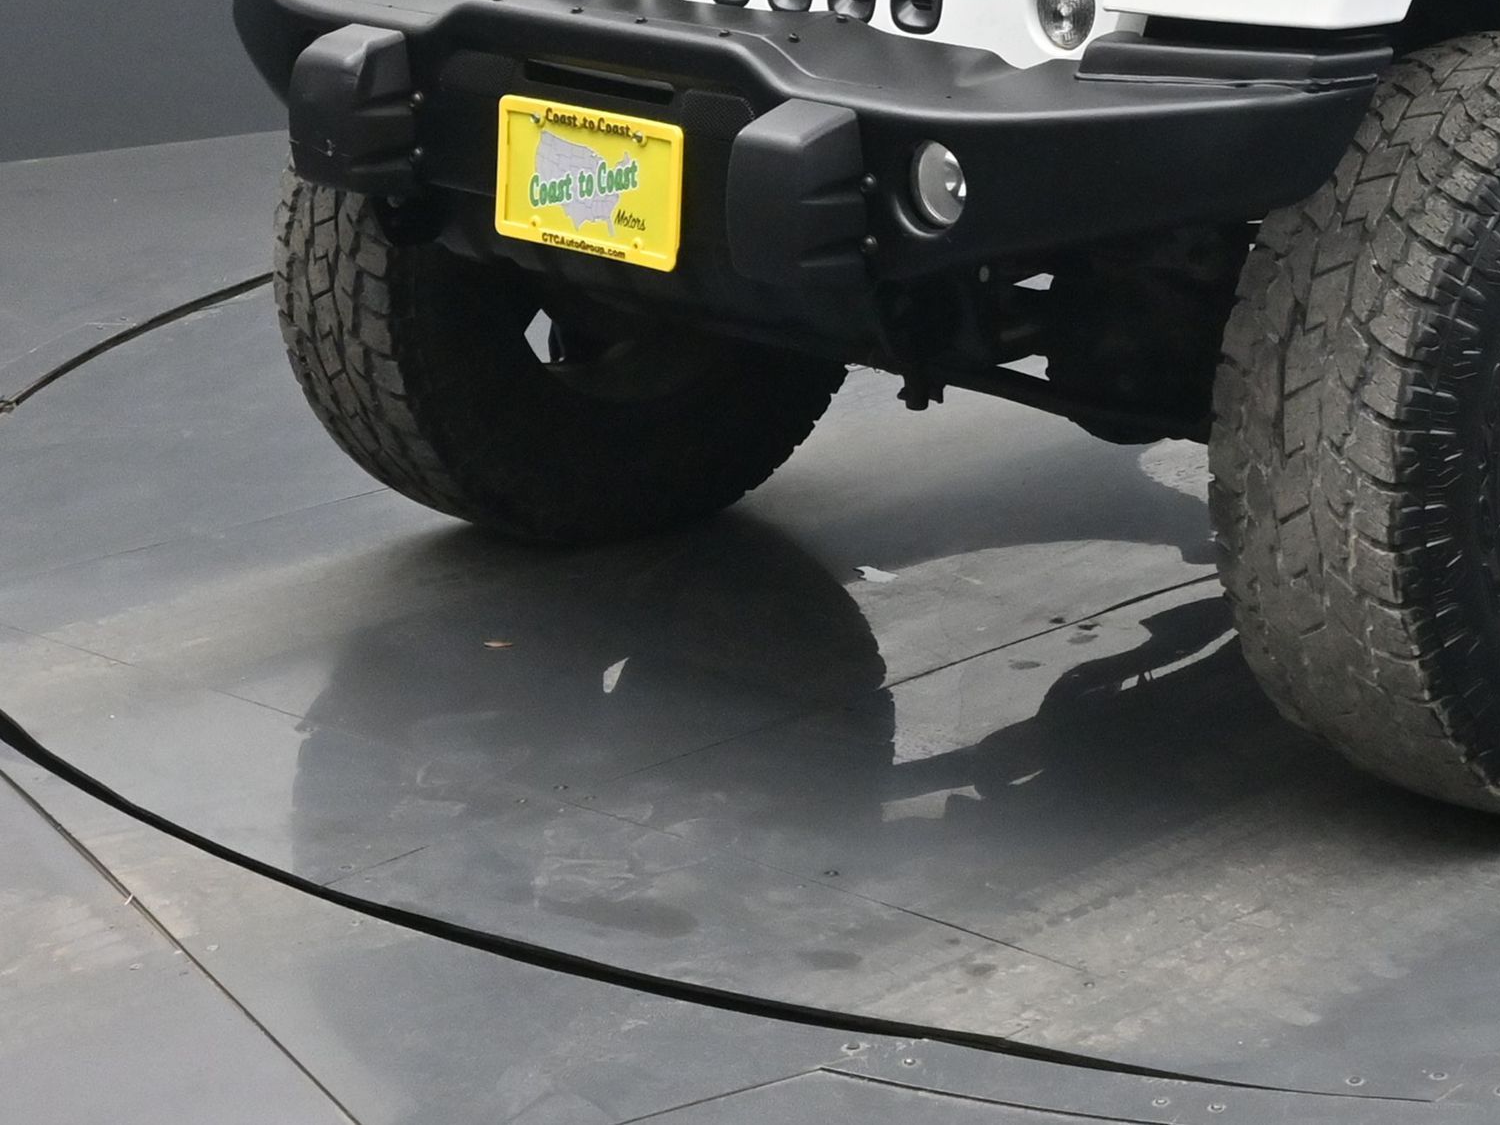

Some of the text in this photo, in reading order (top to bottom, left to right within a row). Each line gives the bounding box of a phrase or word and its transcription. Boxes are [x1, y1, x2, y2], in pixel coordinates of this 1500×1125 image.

[545, 108, 631, 139] Coast to Coast
[529, 160, 639, 207] Coast to Coast
[614, 208, 647, 232] Motors
[541, 231, 626, 260] CTCAutoGroup.com
